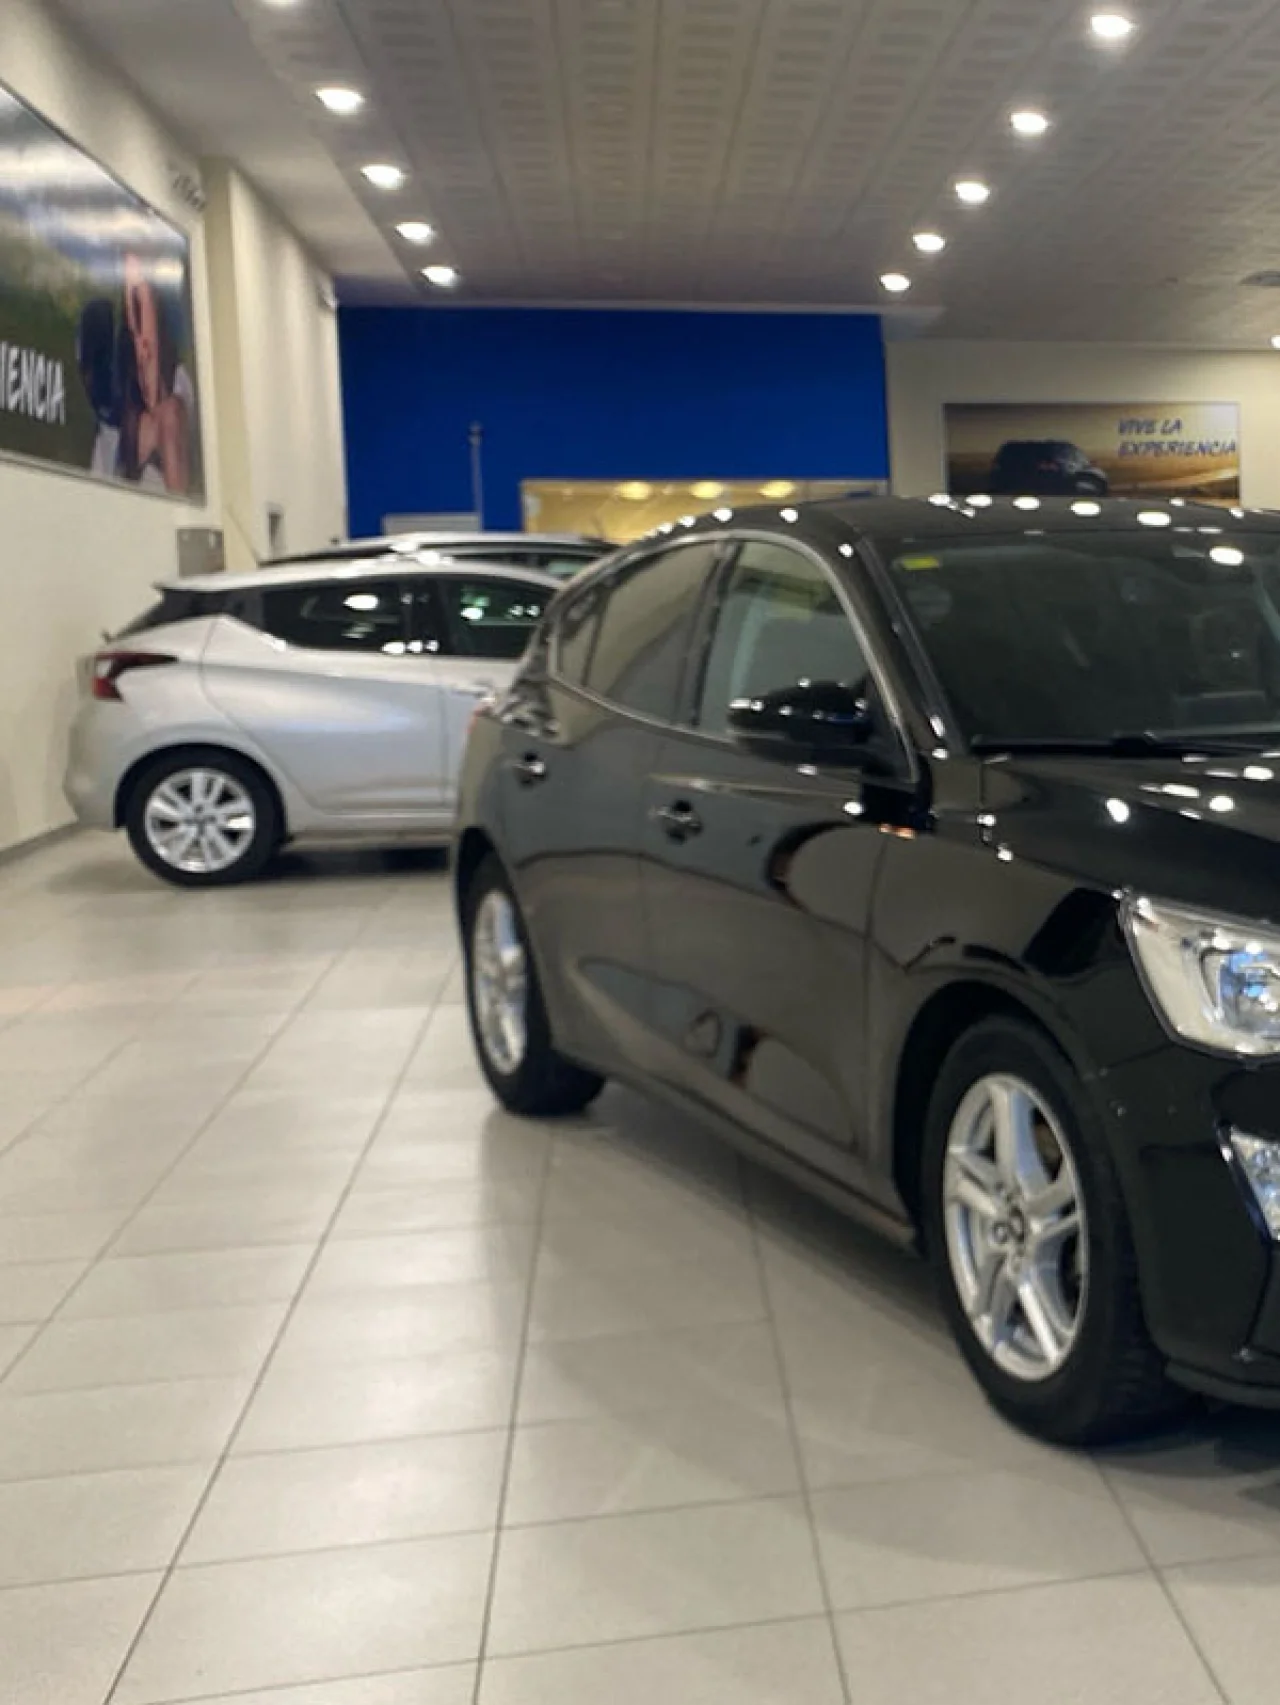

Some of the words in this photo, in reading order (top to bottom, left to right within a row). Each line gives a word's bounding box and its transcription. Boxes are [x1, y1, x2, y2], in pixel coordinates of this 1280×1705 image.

[0, 341, 65, 426] IENCIA
[1118, 418, 1155, 435] VIVE
[1160, 417, 1183, 435] LA
[1117, 440, 1236, 457] EXPERIENCIA
